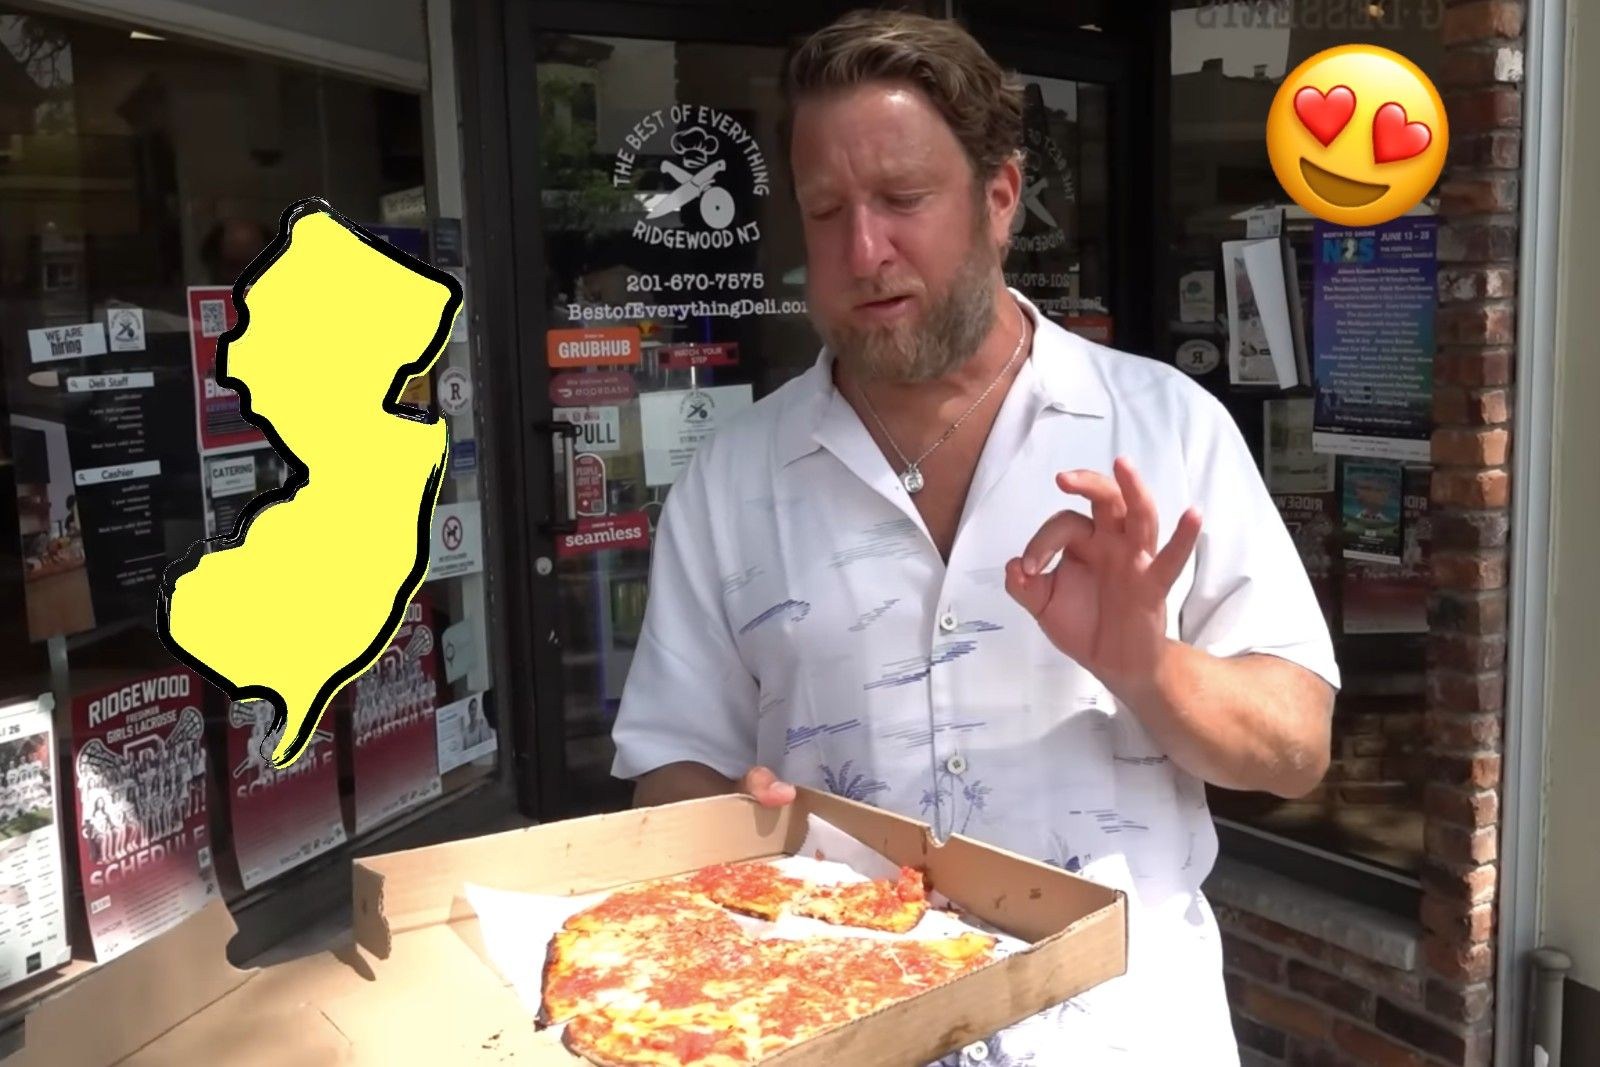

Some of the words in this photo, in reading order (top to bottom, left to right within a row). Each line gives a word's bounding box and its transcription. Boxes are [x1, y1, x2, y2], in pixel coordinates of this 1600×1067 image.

[613, 147, 636, 188] THE
[625, 109, 665, 151] BEST
[670, 104, 692, 124] OF
[697, 105, 770, 197] EVERYTHING
[632, 219, 734, 249] RIDGEWOOD
[736, 220, 761, 245] NJ
[1380, 232, 1402, 241] JUNE
[626, 272, 764, 293] 201-670-7575
[45, 329, 62, 341] WE
[64, 327, 83, 338] ARE
[50, 338, 82, 356] hiring
[558, 339, 631, 359] GRUBHUB
[674, 349, 700, 357] WATCH
[702, 347, 722, 356] YOUR
[691, 356, 707, 364] STEP
[89, 379, 106, 388] Deli
[108, 376, 128, 387] Staff
[450, 383, 462, 400] R
[575, 386, 629, 396] DOORDASH
[574, 422, 616, 444] PULL
[101, 469, 134, 480] Cashier
[213, 464, 253, 478] CATERING
[565, 526, 642, 547] seamless
[88, 674, 190, 728] RIDGEWOOD
[9, 724, 20, 735] 26
[106, 724, 134, 744] GIRLS
[134, 709, 178, 735] LACROSSE
